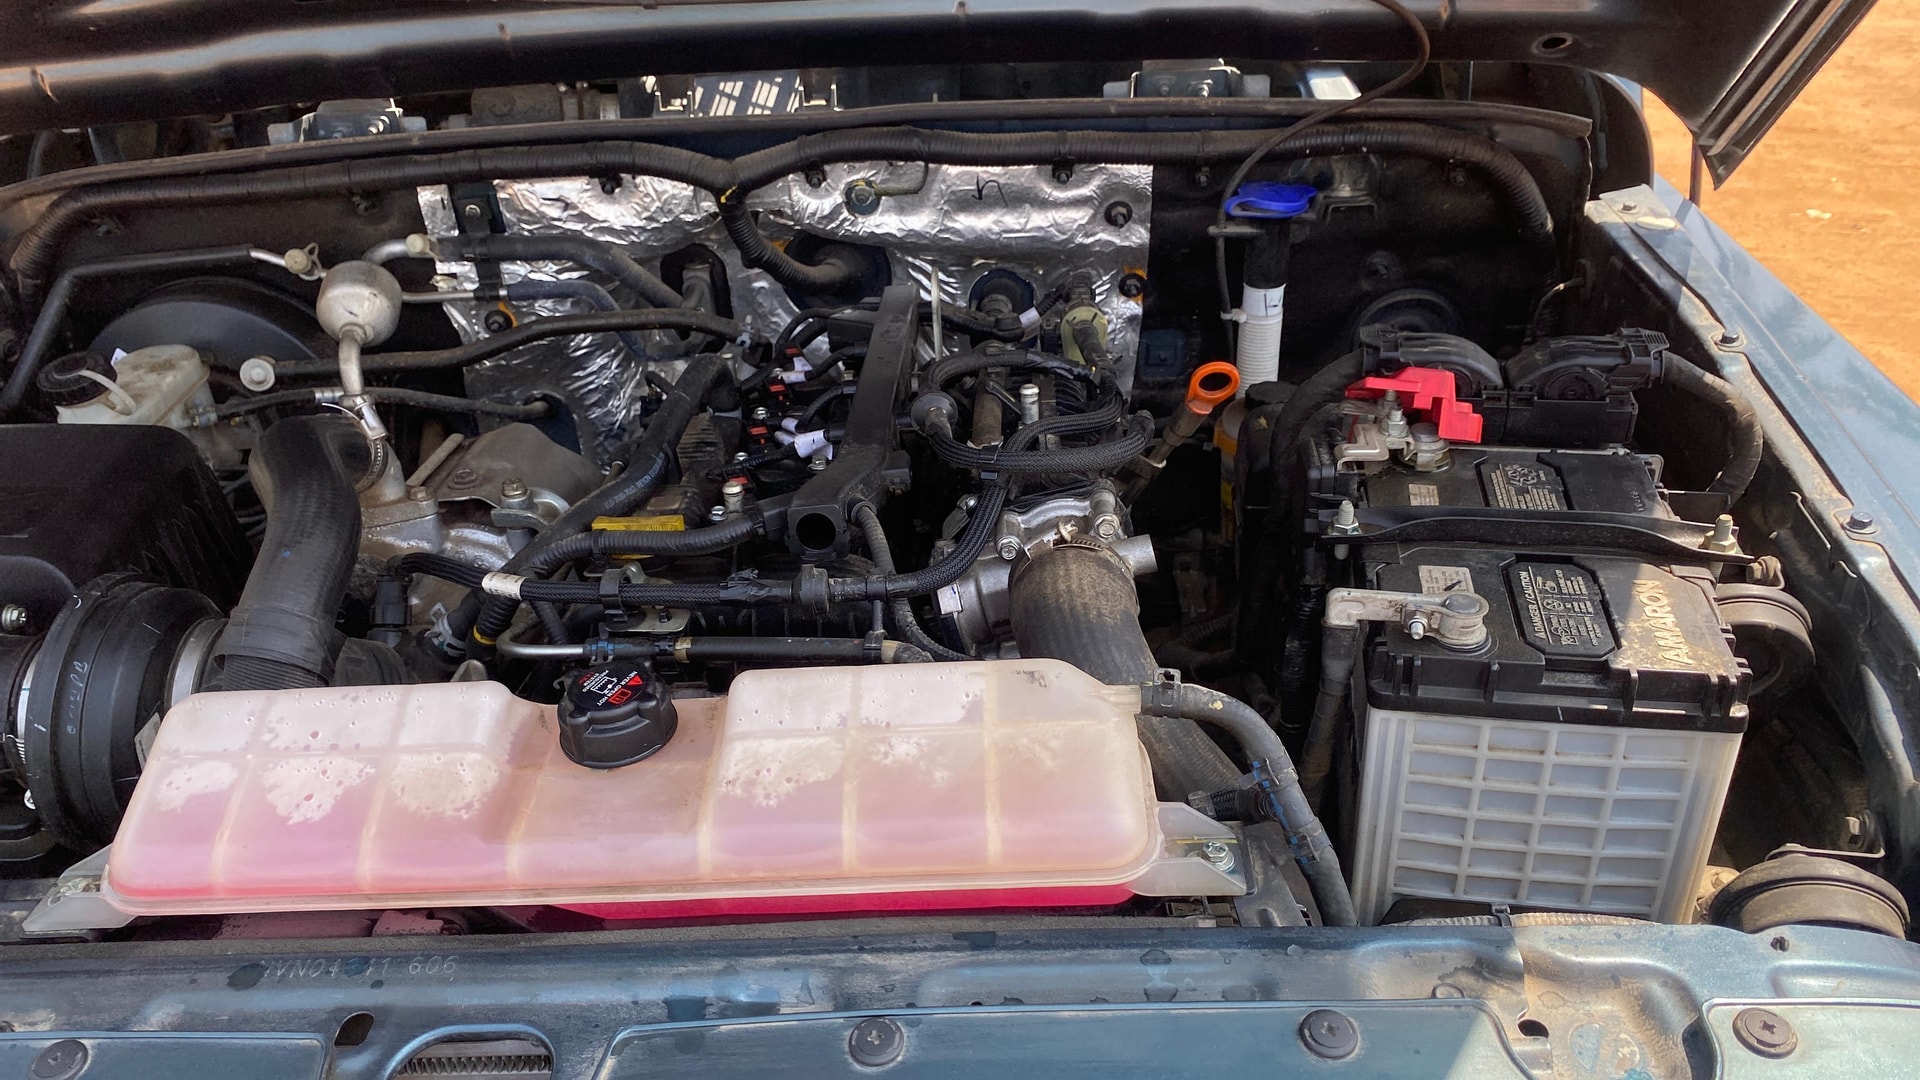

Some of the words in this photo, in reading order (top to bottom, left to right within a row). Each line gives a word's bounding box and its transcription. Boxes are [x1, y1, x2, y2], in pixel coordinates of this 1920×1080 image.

[1518, 571, 1535, 600] CAUTION
[1528, 604, 1546, 632] DANGER
[1632, 579, 1694, 665] AMARON
[619, 671, 638, 686] NEVER
[596, 696, 609, 706] HOT
[607, 684, 622, 698] OPEN
[408, 955, 459, 975] 606
